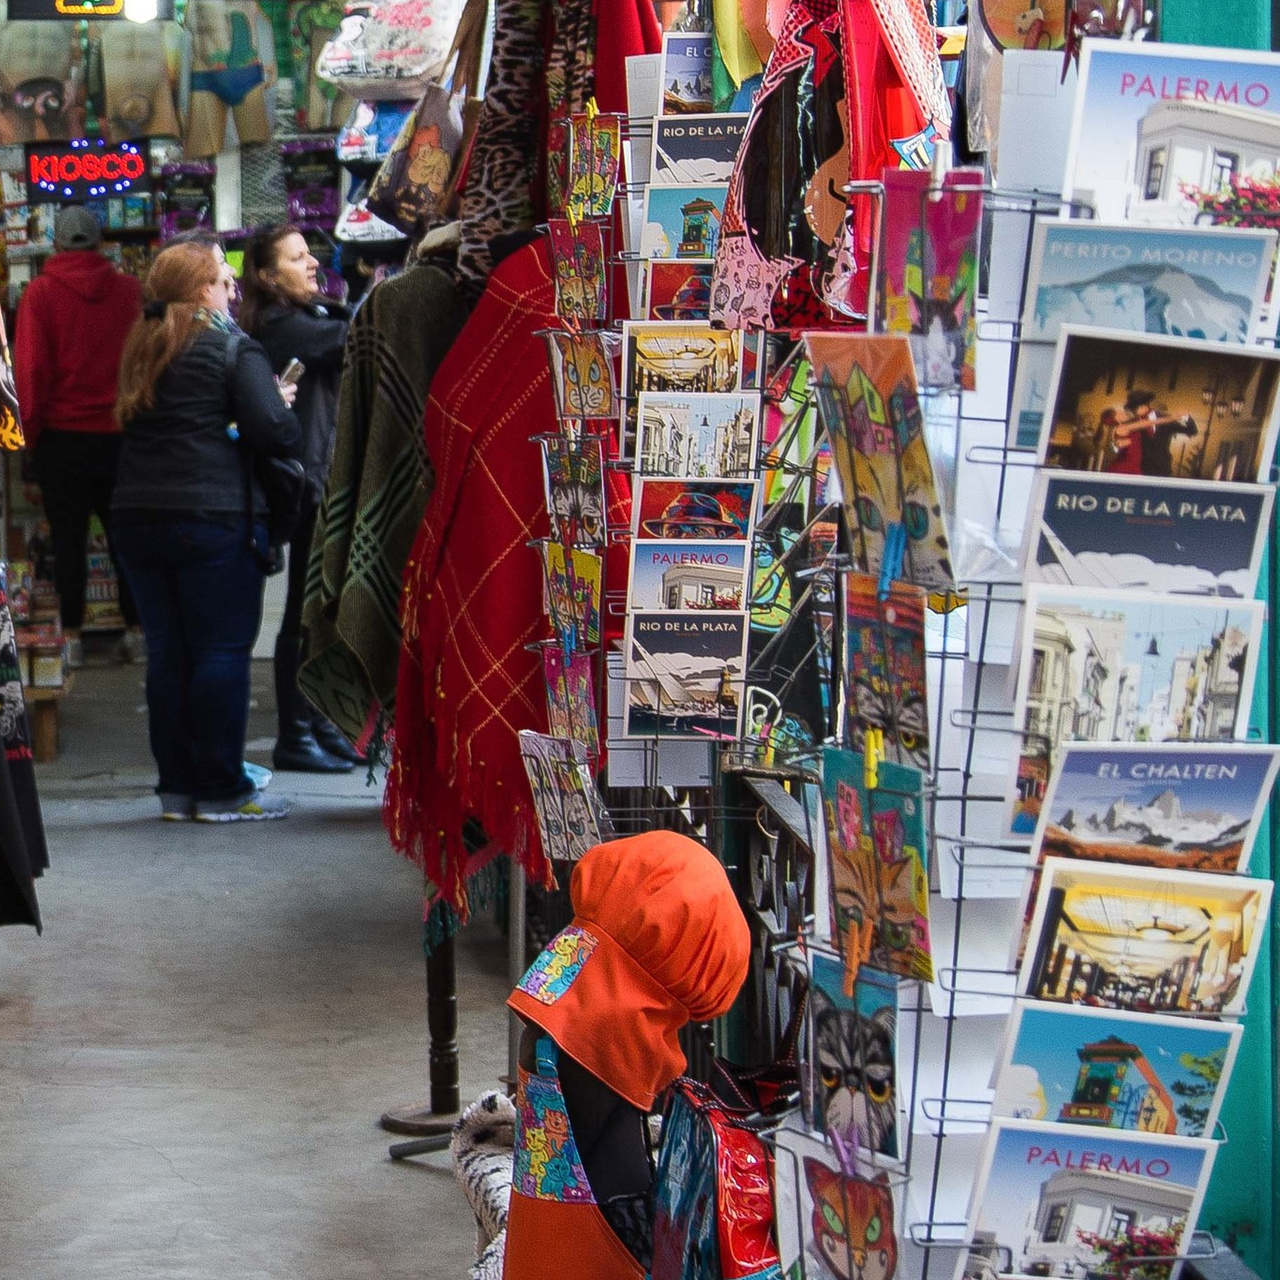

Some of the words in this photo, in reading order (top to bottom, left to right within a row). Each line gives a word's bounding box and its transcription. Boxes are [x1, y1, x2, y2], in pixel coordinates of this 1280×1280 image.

[685, 46, 699, 58] EL
[1120, 72, 1269, 108] PALERMO
[663, 127, 685, 137] RIO
[689, 126, 705, 136] DE
[708, 126, 723, 135] LA
[726, 125, 747, 135] PLA
[30, 152, 145, 184] KIOSCO
[1048, 240, 1132, 260] PERITO
[1140, 243, 1258, 267] MORENO
[1056, 494, 1098, 511] RIO
[1106, 496, 1135, 513] DE
[1144, 499, 1170, 517] LA
[1179, 502, 1247, 523] PLATA
[652, 551, 729, 566] PALERMO
[639, 621, 660, 632] RIO
[665, 621, 681, 632] DE
[683, 621, 699, 632] LA
[702, 621, 738, 633] PLATA
[1097, 762, 1121, 779] EL
[1131, 762, 1238, 781] CHALTEN
[1026, 1145, 1171, 1178] PALERMO
